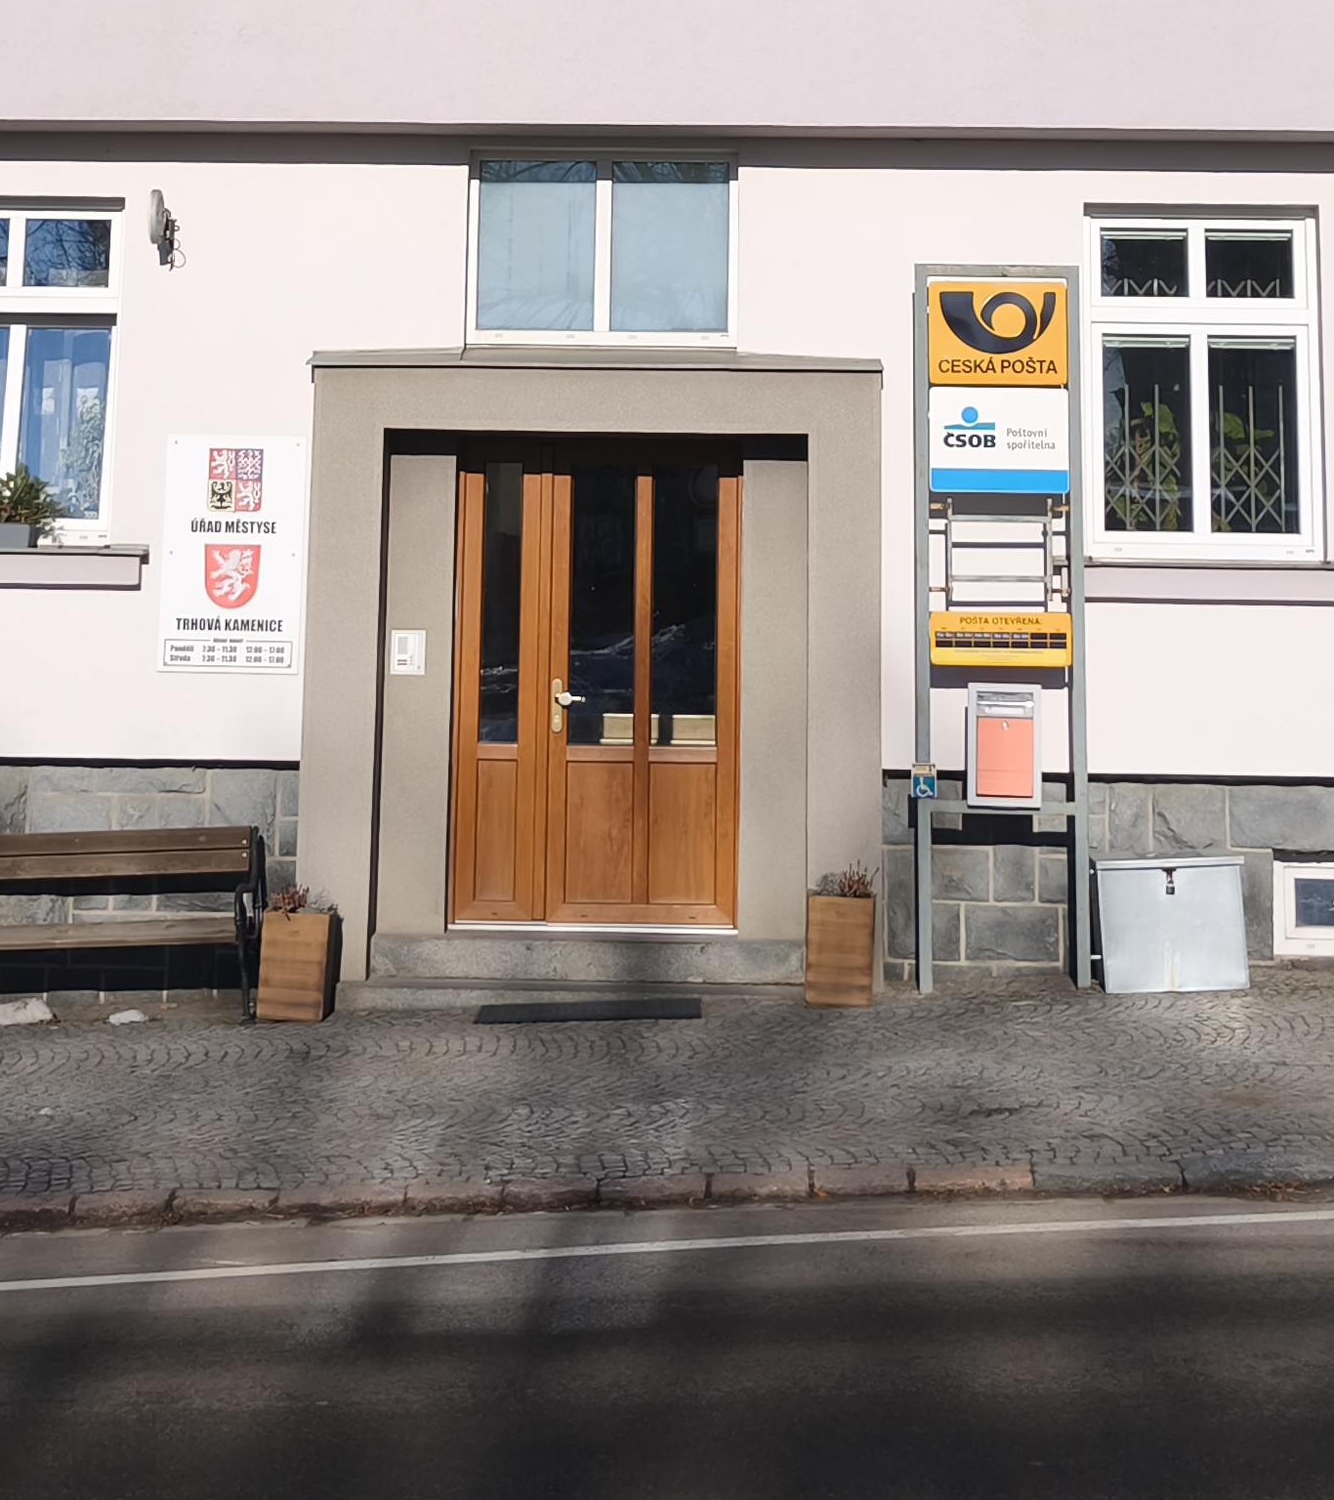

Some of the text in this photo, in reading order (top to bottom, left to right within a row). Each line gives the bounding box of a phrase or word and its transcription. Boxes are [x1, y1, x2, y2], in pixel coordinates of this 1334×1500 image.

[1001, 357, 1058, 374] POŠTA
[943, 432, 997, 448] ČSOB
[1006, 428, 1048, 438] Poštovní
[1006, 440, 1056, 451] spořitelna
[191, 517, 277, 534] ÚŘAD MĚSTYSE
[176, 616, 284, 632] TRHOVÁ KAMENICE
